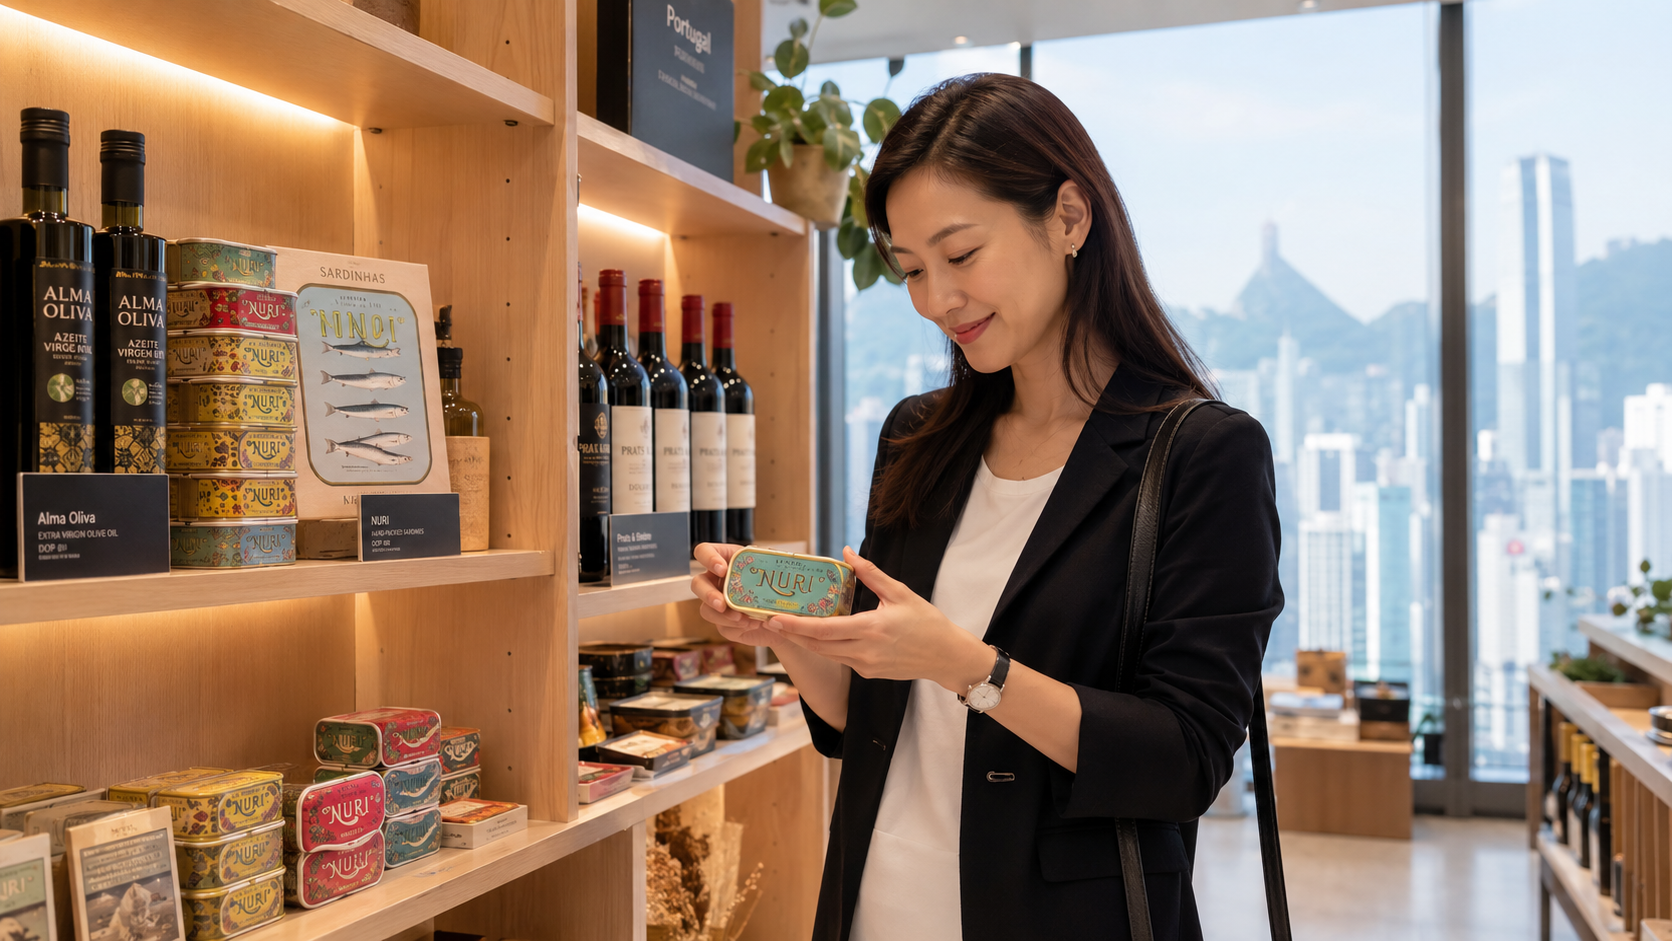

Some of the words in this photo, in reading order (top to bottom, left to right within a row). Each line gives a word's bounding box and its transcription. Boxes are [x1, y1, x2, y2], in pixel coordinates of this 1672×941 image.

[667, 4, 711, 55] Portugal
[320, 266, 386, 284] SARDINHAS
[43, 286, 92, 304] ALMA
[118, 295, 163, 312] ALMA
[43, 303, 93, 321] OLIVA
[247, 300, 280, 320] NURI
[118, 311, 165, 329] OLIVA
[54, 332, 88, 344] AZEITE
[128, 339, 159, 350] AZEITE
[250, 347, 280, 368] NURI
[250, 394, 280, 414] NURI
[251, 441, 281, 460] NURI
[250, 487, 280, 507] NURI
[37, 512, 66, 525] Alma
[69, 511, 96, 524] Oliva
[371, 515, 390, 526] NURI
[38, 530, 61, 540] EXTRA
[87, 529, 106, 538] OLIVE
[107, 528, 119, 537] OIL
[38, 544, 56, 553] DOP
[756, 568, 814, 597] NURI
[233, 793, 265, 817] NURI
[329, 796, 370, 826] NURI
